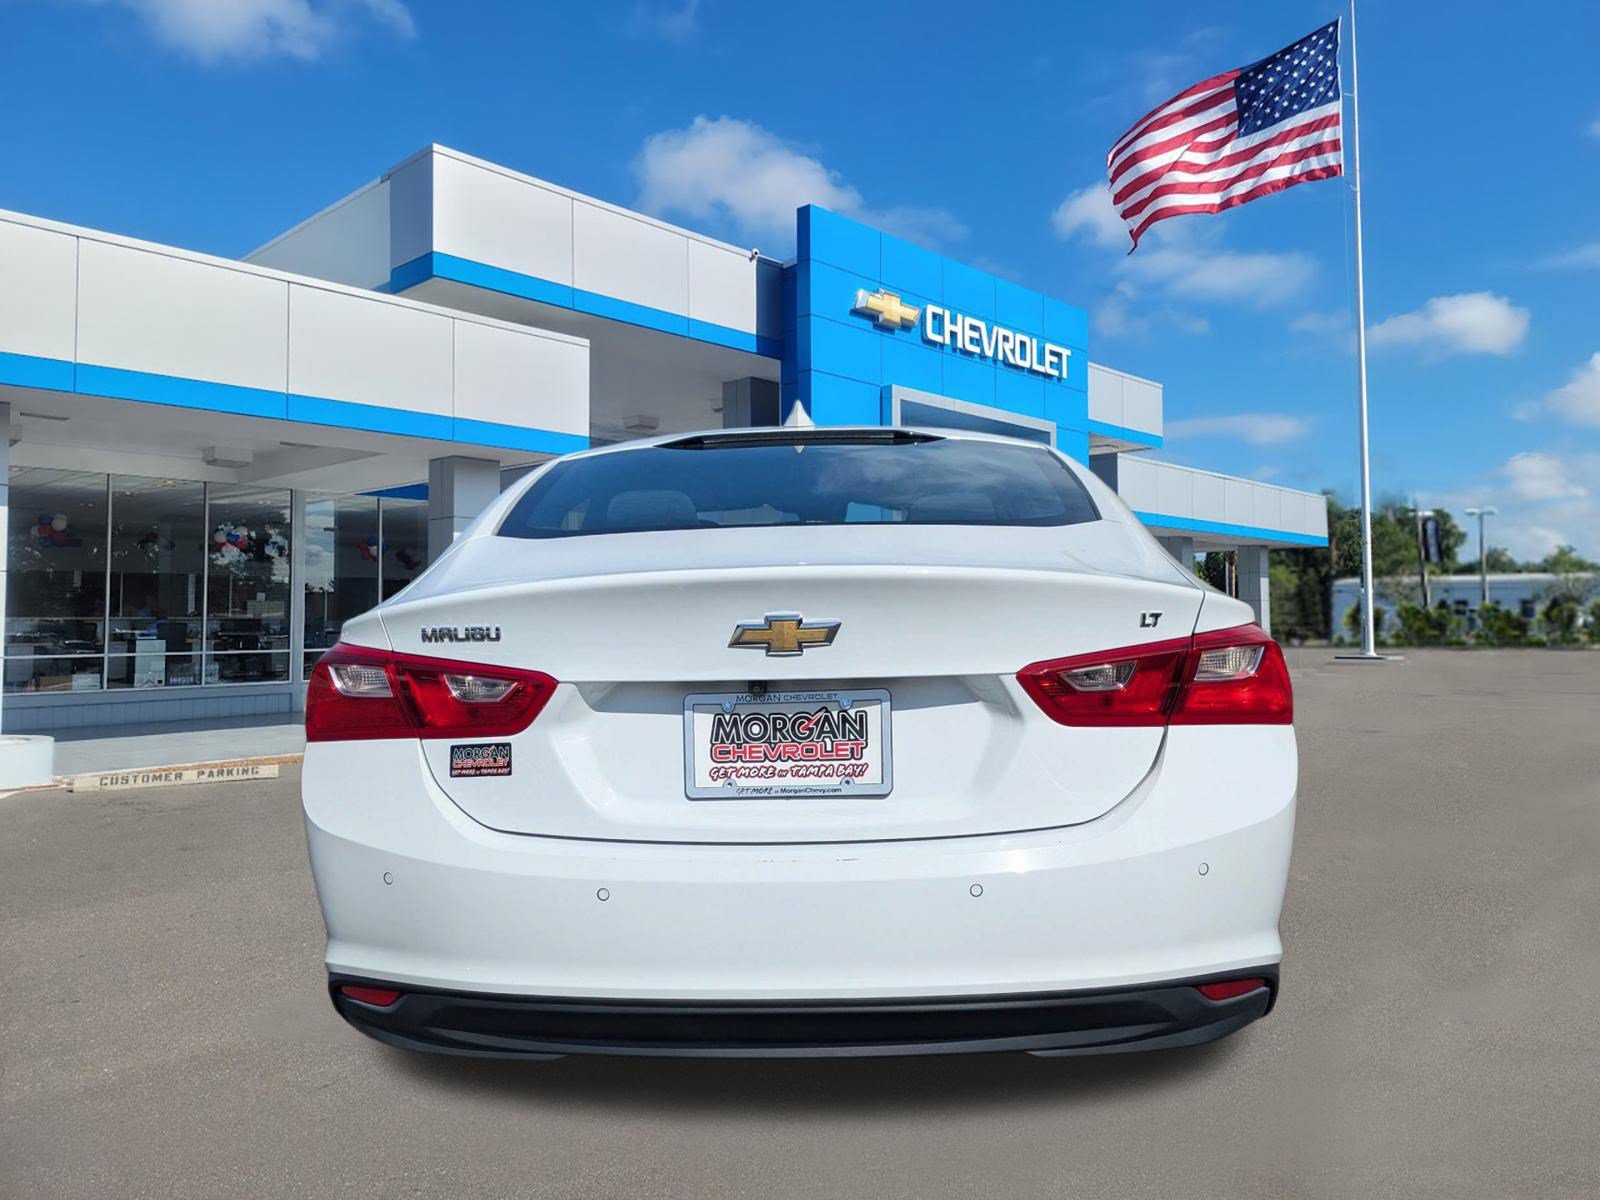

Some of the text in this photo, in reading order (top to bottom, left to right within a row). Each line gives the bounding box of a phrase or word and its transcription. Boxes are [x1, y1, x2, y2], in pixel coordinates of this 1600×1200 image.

[923, 304, 1072, 379] CHEVROLET
[1140, 612, 1162, 628] LT
[421, 626, 501, 643] MALIBU
[736, 693, 838, 703] MORGAN CHEVROLET
[712, 708, 867, 744] MORGAN
[453, 746, 510, 760] MORGAN
[712, 740, 866, 761] CHEVROLET
[453, 758, 508, 768] CHEVROLET
[100, 766, 259, 786] CUSTOMER PARKING
[710, 767, 736, 781] GET
[737, 765, 776, 779] MORE
[791, 764, 833, 778] TAMPA
[836, 763, 868, 777] BAY!
[751, 787, 774, 795] MORE
[780, 787, 842, 795] MorganChevy.com
